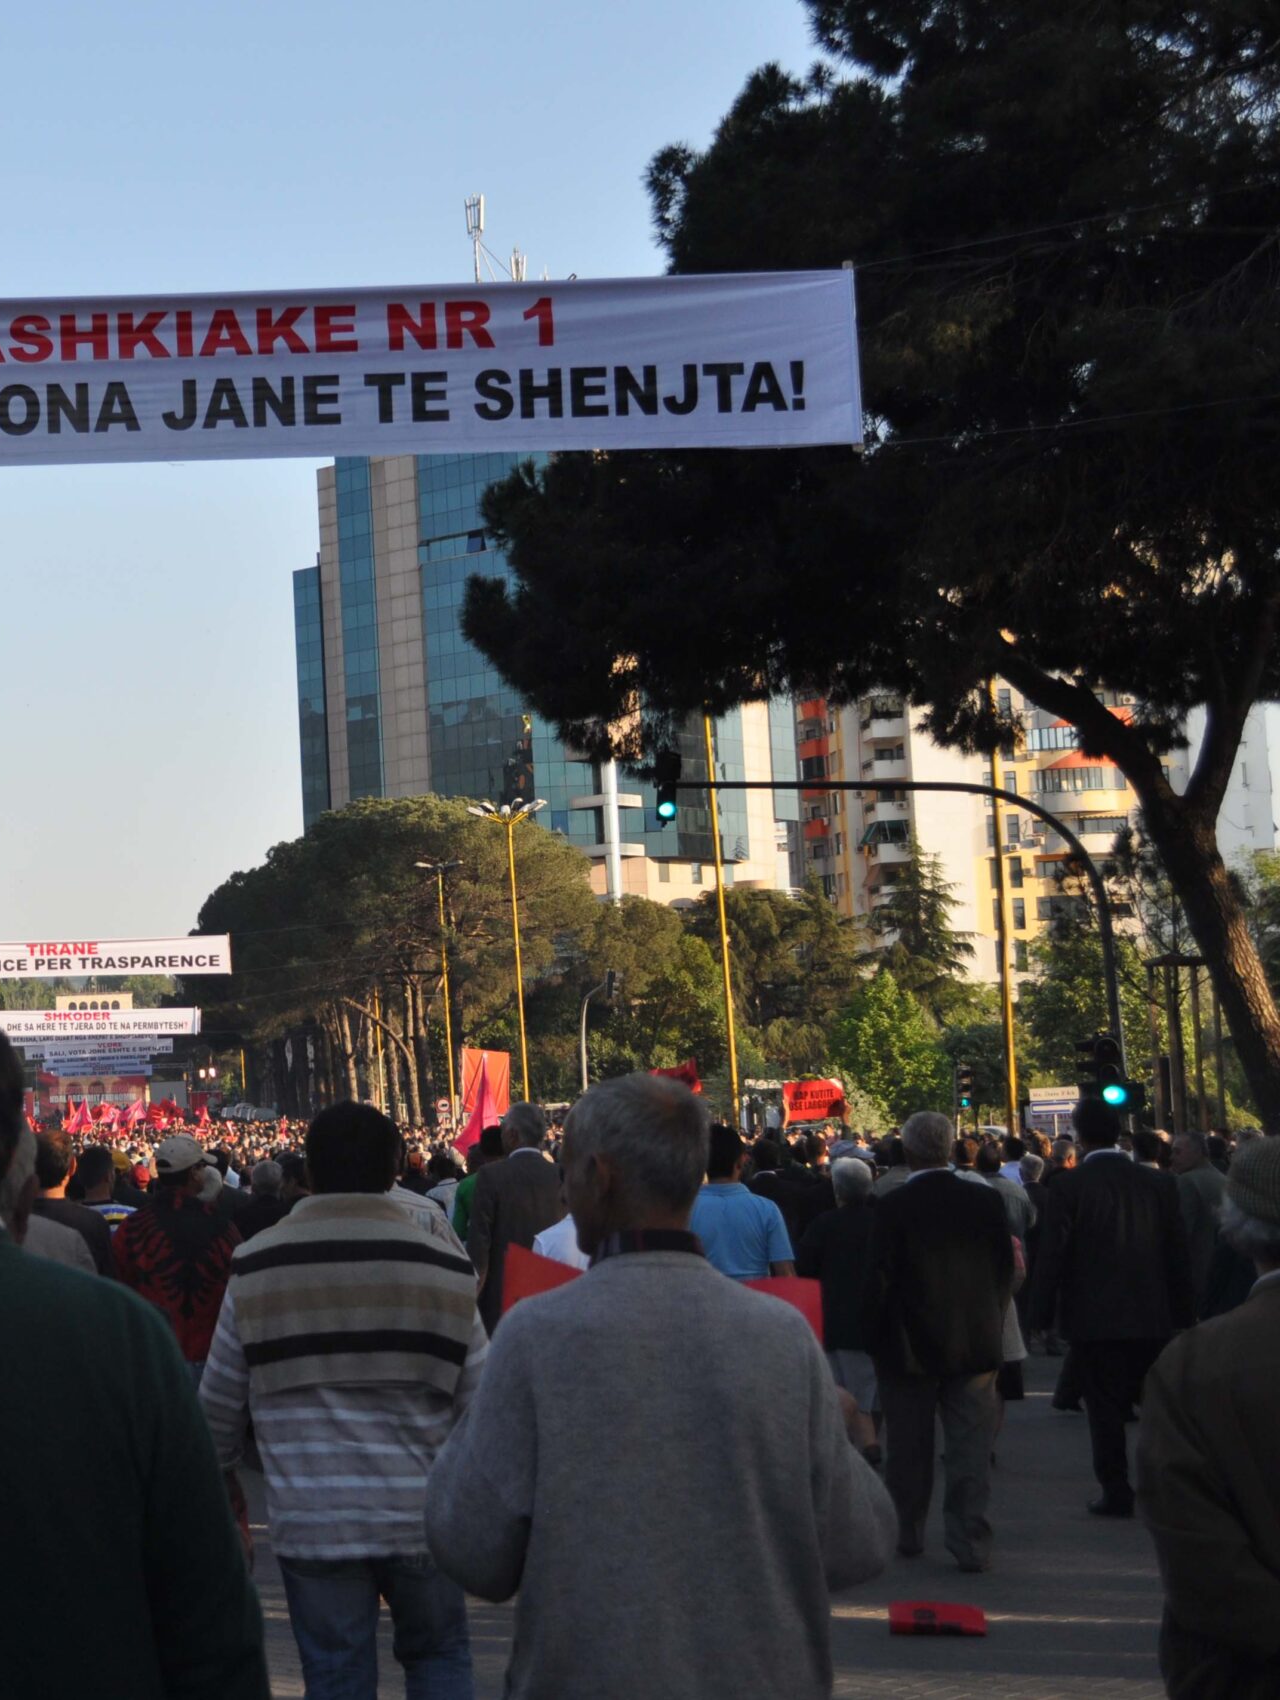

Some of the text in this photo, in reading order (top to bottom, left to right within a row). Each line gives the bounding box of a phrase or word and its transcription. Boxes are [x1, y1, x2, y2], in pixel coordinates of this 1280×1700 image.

[387, 301, 496, 353] NR
[524, 297, 555, 347] 1
[161, 374, 343, 431] JANE
[364, 371, 450, 424] TE
[474, 360, 807, 421] SHENJTA!
[26, 942, 99, 957] TIRANE
[34, 957, 72, 970] PER
[78, 954, 221, 970] TRASPARENCE
[43, 1012, 111, 1021] SHKODER
[7, 1022, 22, 1032] DHE
[24, 1022, 34, 1031] SA
[36, 1022, 56, 1031] HERE
[59, 1022, 68, 1031] TE
[70, 1022, 94, 1031] TJERA
[96, 1022, 107, 1031] DO
[109, 1022, 118, 1030] TE
[120, 1022, 131, 1030] NA
[133, 1021, 188, 1030] PERMBYTESH?
